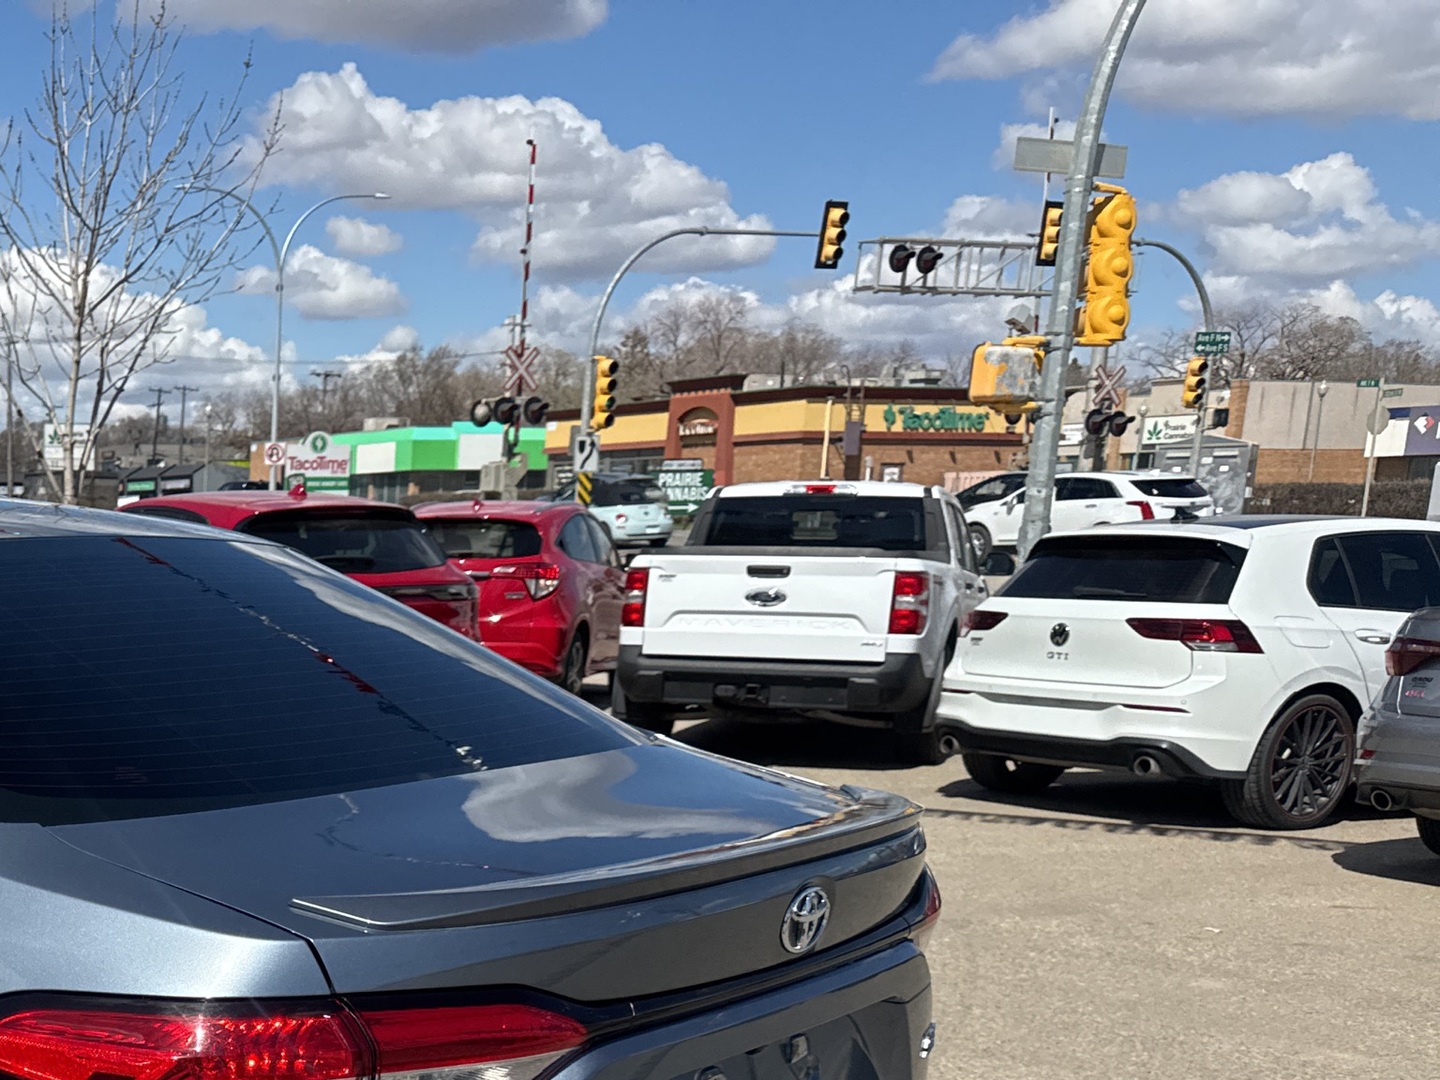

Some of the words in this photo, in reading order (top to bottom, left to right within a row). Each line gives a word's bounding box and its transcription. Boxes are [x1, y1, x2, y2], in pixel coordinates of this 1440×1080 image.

[288, 456, 348, 471] TacoTime
[658, 472, 705, 487] PRAIRIE
[1046, 651, 1070, 660] GTI
